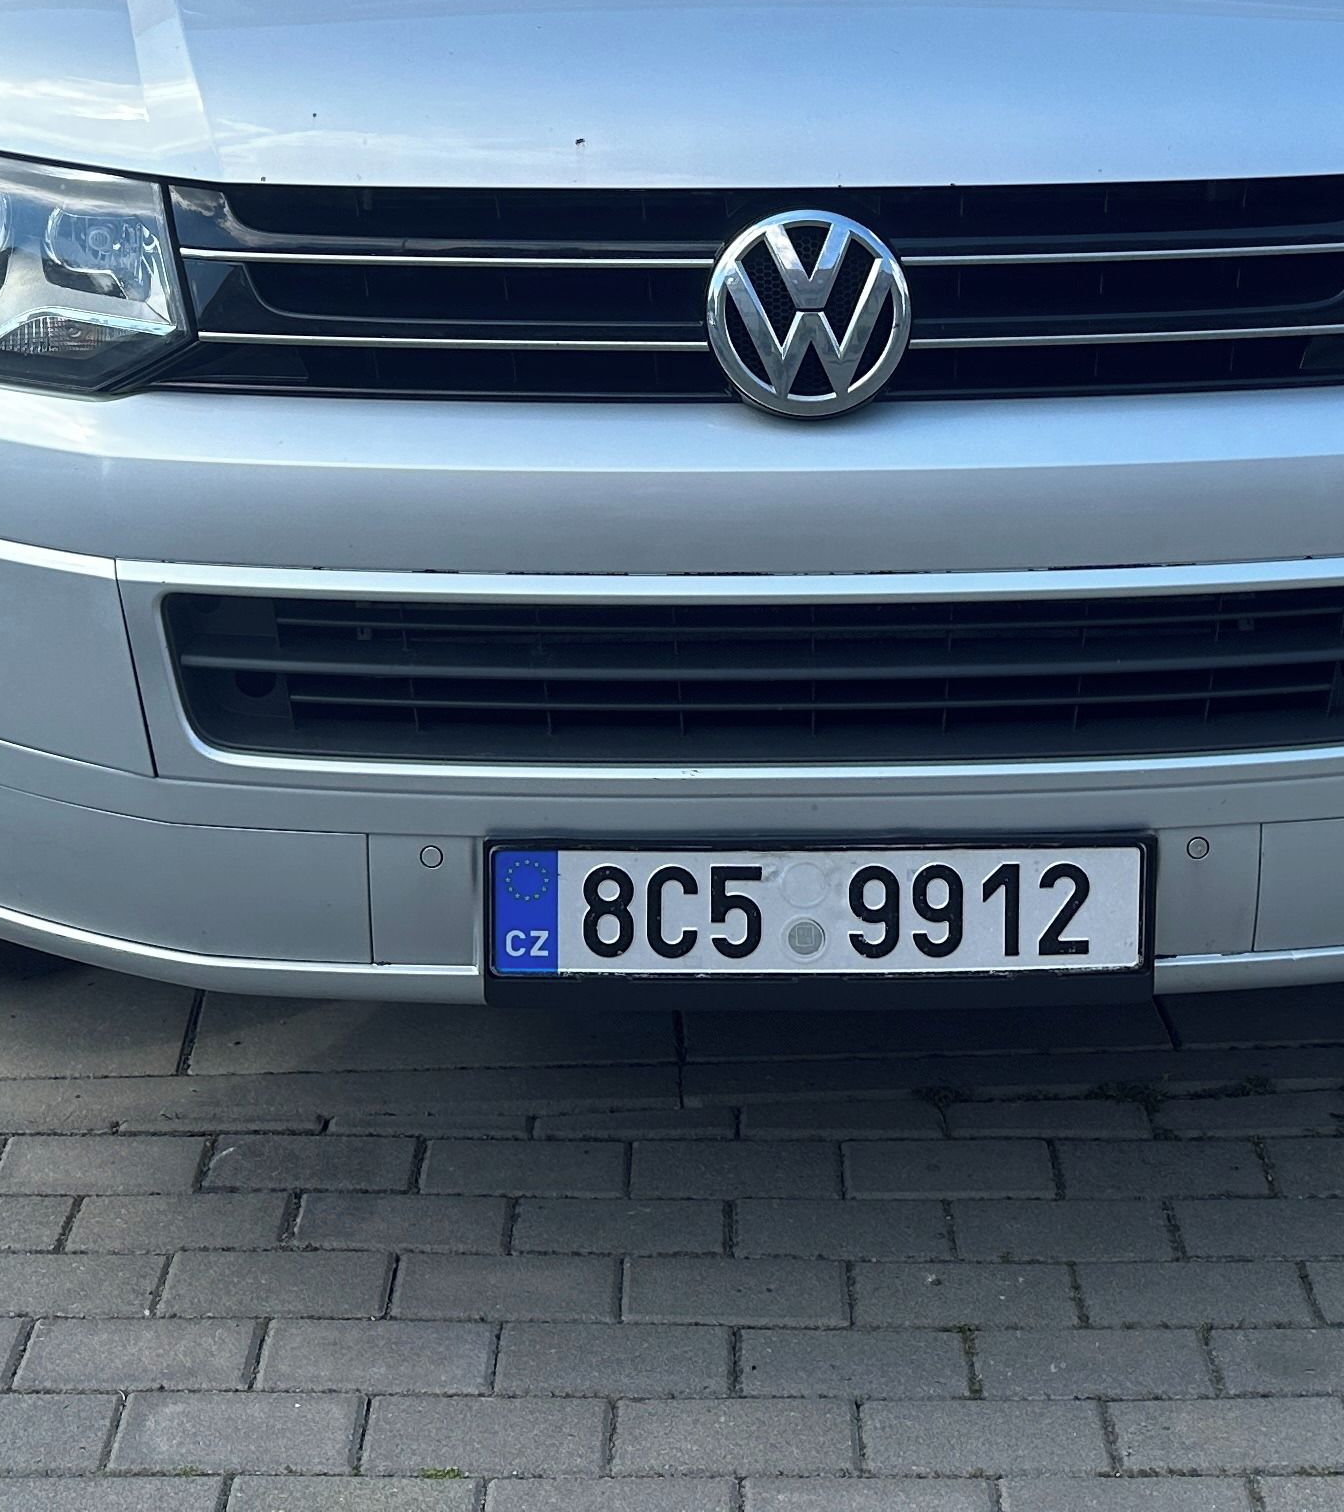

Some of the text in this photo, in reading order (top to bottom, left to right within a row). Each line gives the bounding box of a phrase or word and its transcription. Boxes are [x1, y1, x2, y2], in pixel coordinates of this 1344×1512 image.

[721, 219, 897, 403] VW
[504, 930, 549, 958] CZ
[581, 862, 1091, 960] 8C5 9912
